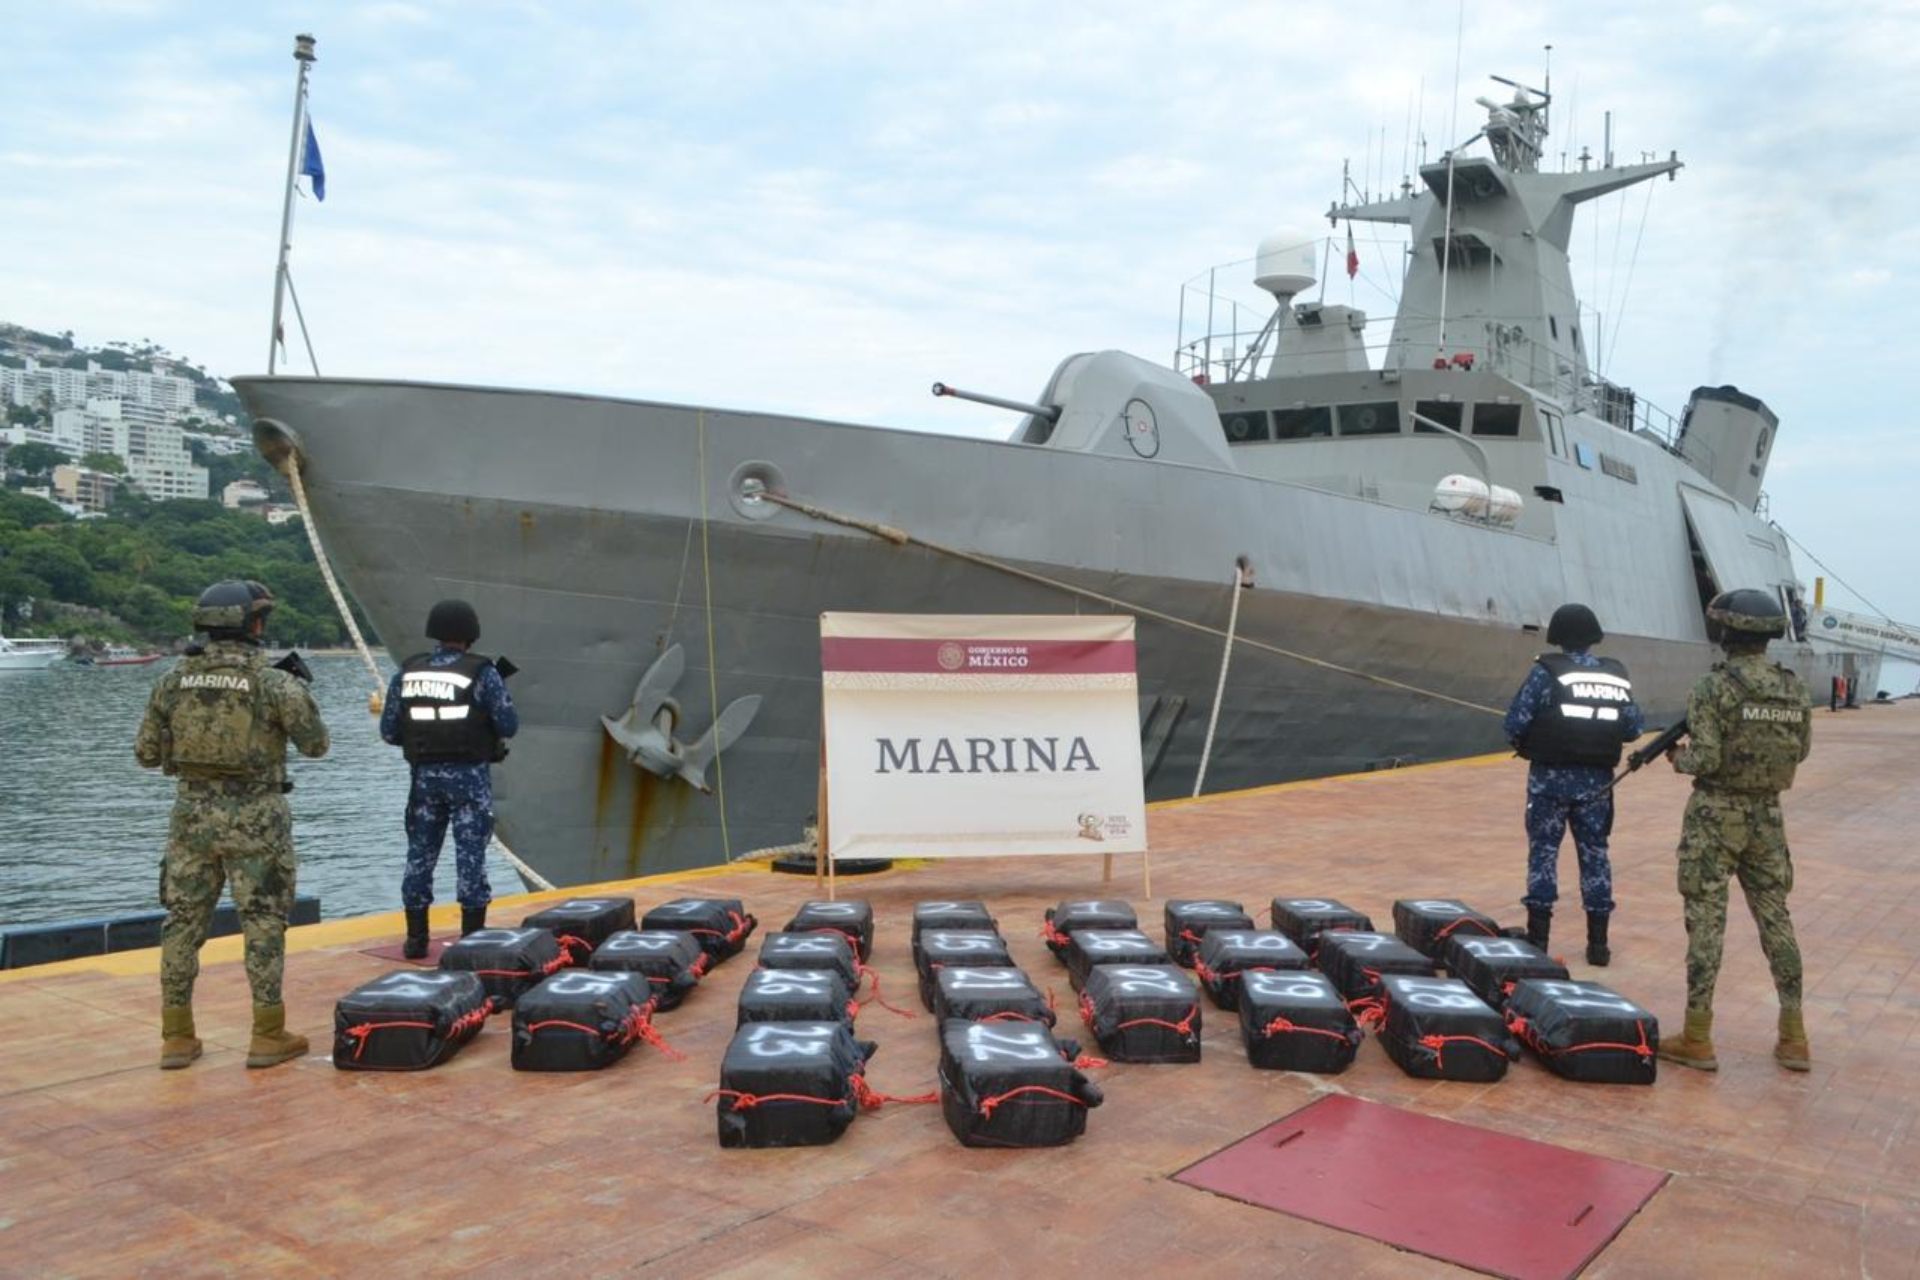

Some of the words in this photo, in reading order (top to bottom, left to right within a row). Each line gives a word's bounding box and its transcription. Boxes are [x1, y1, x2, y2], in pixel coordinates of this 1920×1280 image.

[968, 651, 1029, 668] MÉXICO
[180, 674, 250, 692] MARINA
[401, 679, 455, 701] MARINA
[1572, 683, 1631, 703] MARINA
[1742, 706, 1802, 723] MARINA
[875, 736, 1100, 774] MARINA
